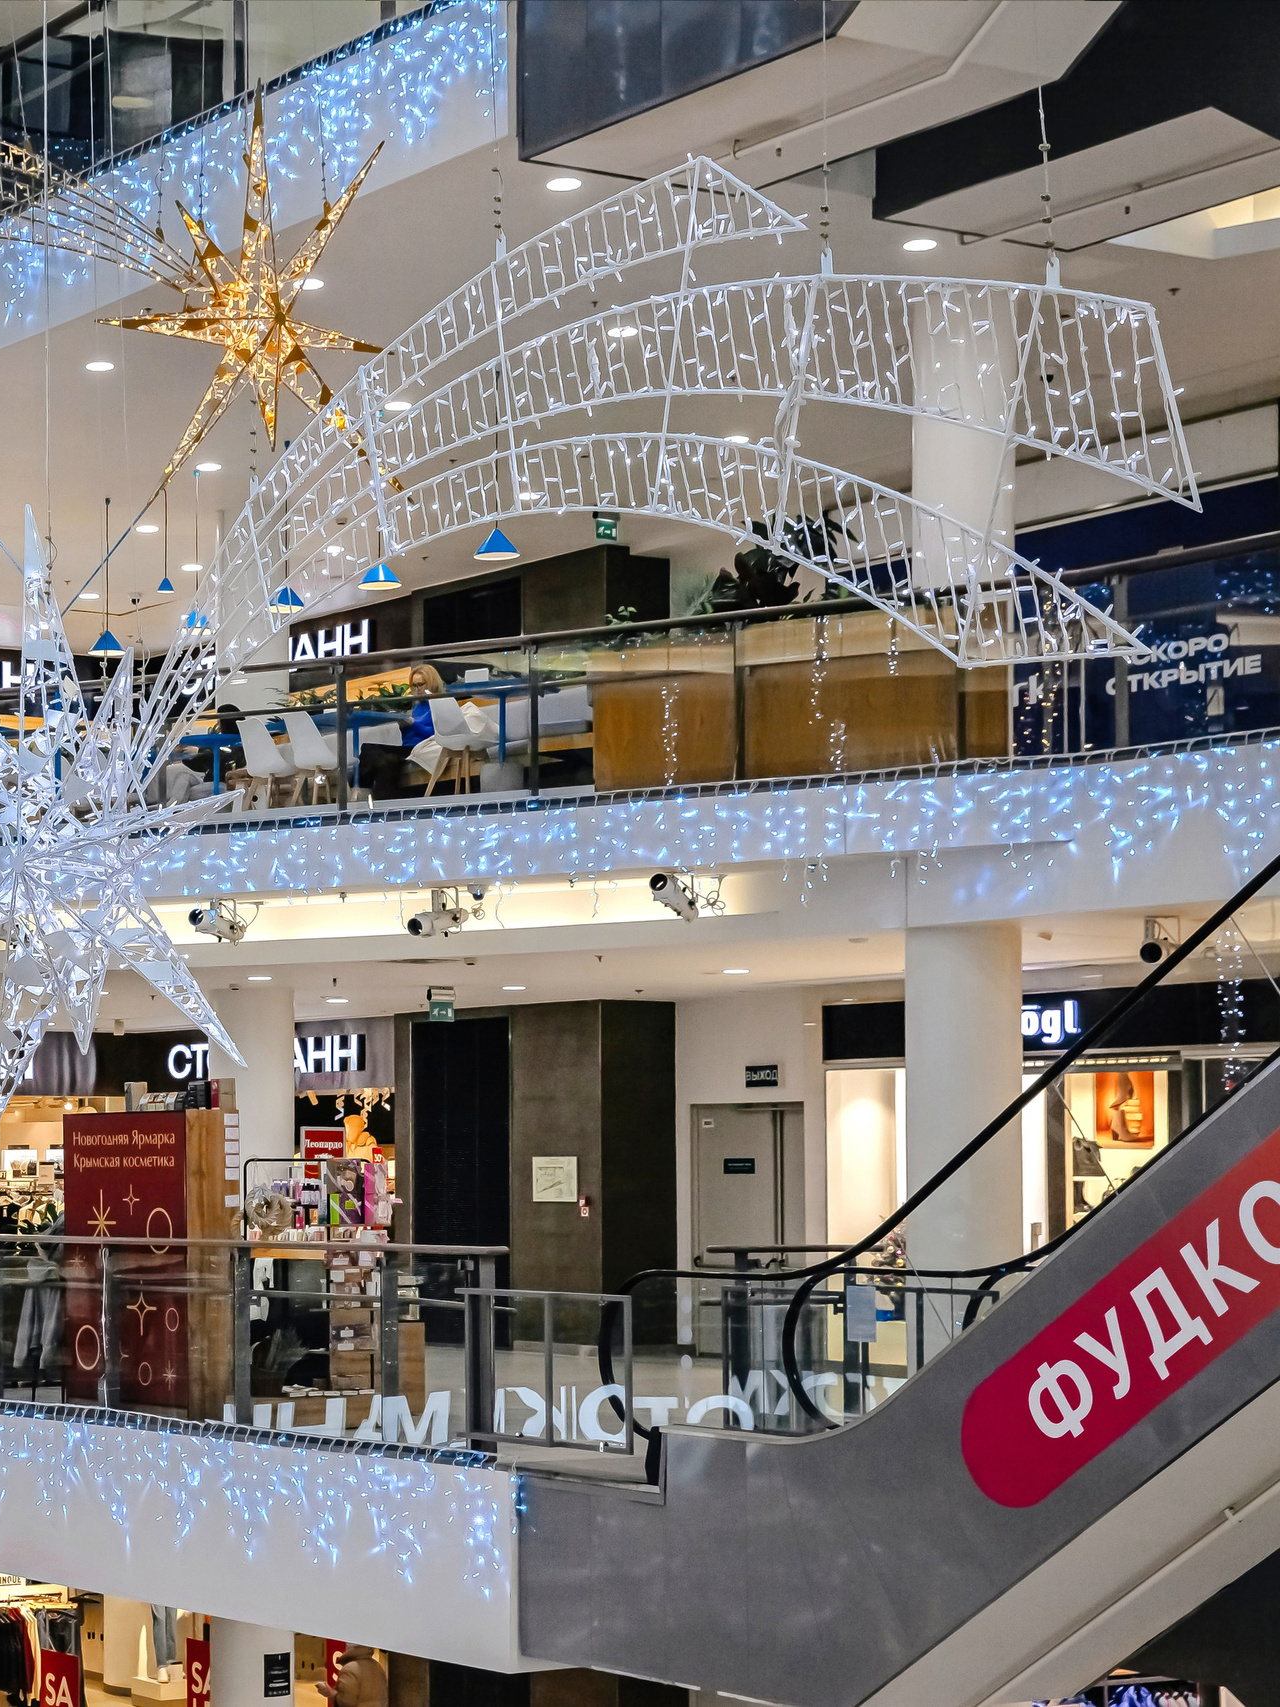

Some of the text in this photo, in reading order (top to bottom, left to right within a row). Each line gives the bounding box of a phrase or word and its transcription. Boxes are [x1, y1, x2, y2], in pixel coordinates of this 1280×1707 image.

[1129, 633, 1229, 667] СКОРО
[745, 1069, 778, 1081] ВЫХОД
[73, 1130, 175, 1149] Новогодняя Ярмарка
[74, 1153, 175, 1172] Крымская косметика
